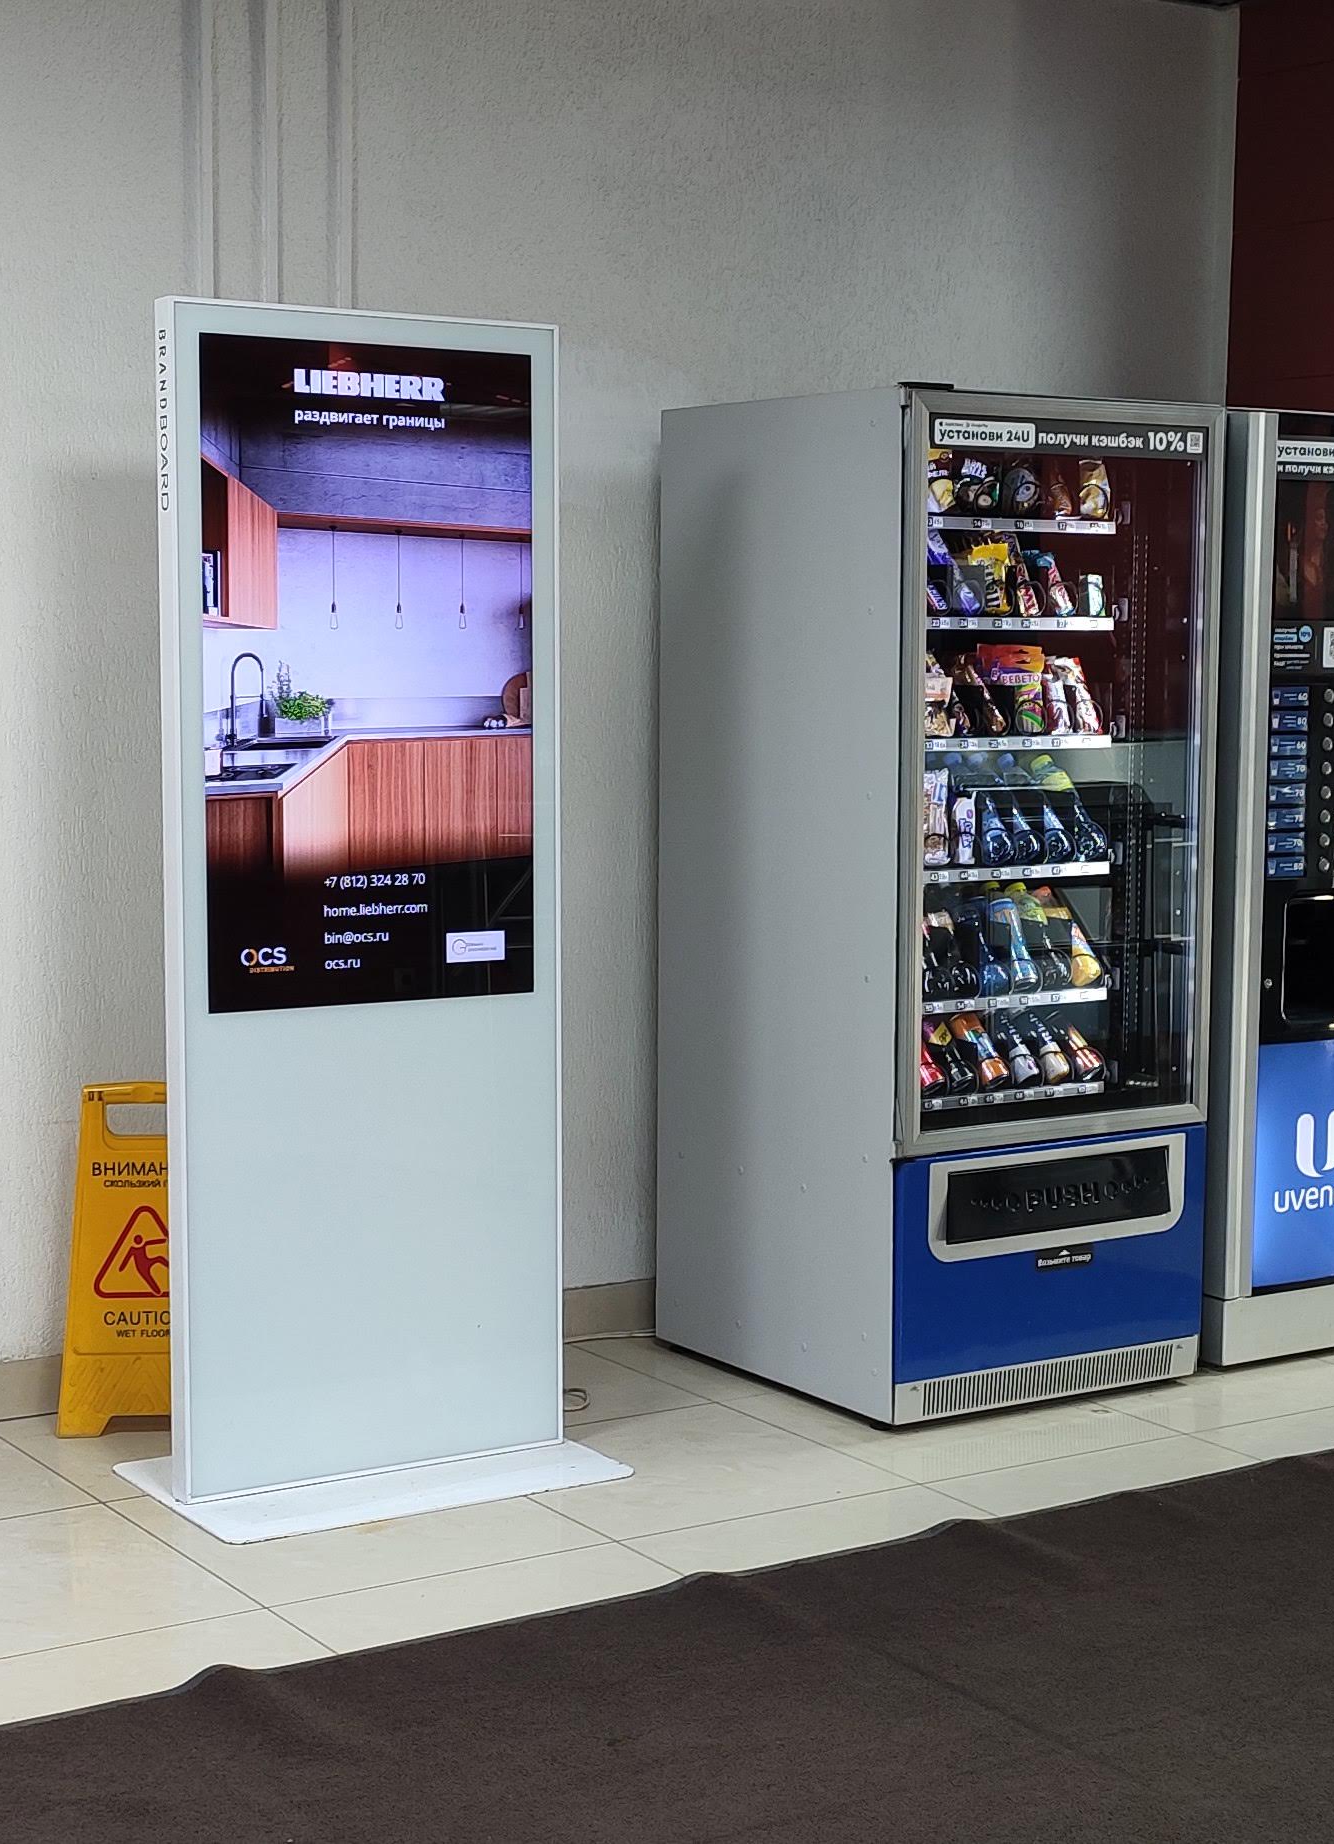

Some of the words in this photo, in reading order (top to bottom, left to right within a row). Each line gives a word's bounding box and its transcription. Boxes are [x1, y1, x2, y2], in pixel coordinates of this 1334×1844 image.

[293, 368, 446, 402] LIEBHERR
[158, 329, 170, 511] BRANDBOARD
[294, 409, 380, 426] раздвигает
[382, 414, 446, 431] границы
[938, 428, 1003, 442] установи
[1006, 430, 1030, 443] 24U
[1038, 432, 1089, 449] получи
[1091, 432, 1144, 449] кэшбэк
[1147, 431, 1185, 451] 10%
[1277, 445, 1334, 458] установи
[1277, 464, 1283, 473] и
[1285, 464, 1322, 476] получи
[1002, 673, 1040, 684] BEBETO
[323, 876, 338, 889] +7
[339, 874, 368, 890] (812)
[369, 874, 393, 887] 324
[394, 873, 409, 886] 28
[411, 872, 426, 886] 70
[323, 902, 429, 918] home.liebherr.com
[324, 931, 390, 945] bin@ocs.ru
[240, 946, 287, 967] OCS
[324, 958, 361, 970] ocs.ru
[103, 1178, 161, 1189] СКОЛЬЗКИЙ
[1025, 1180, 1100, 1213] PUSH
[116, 1328, 136, 1338] WET
